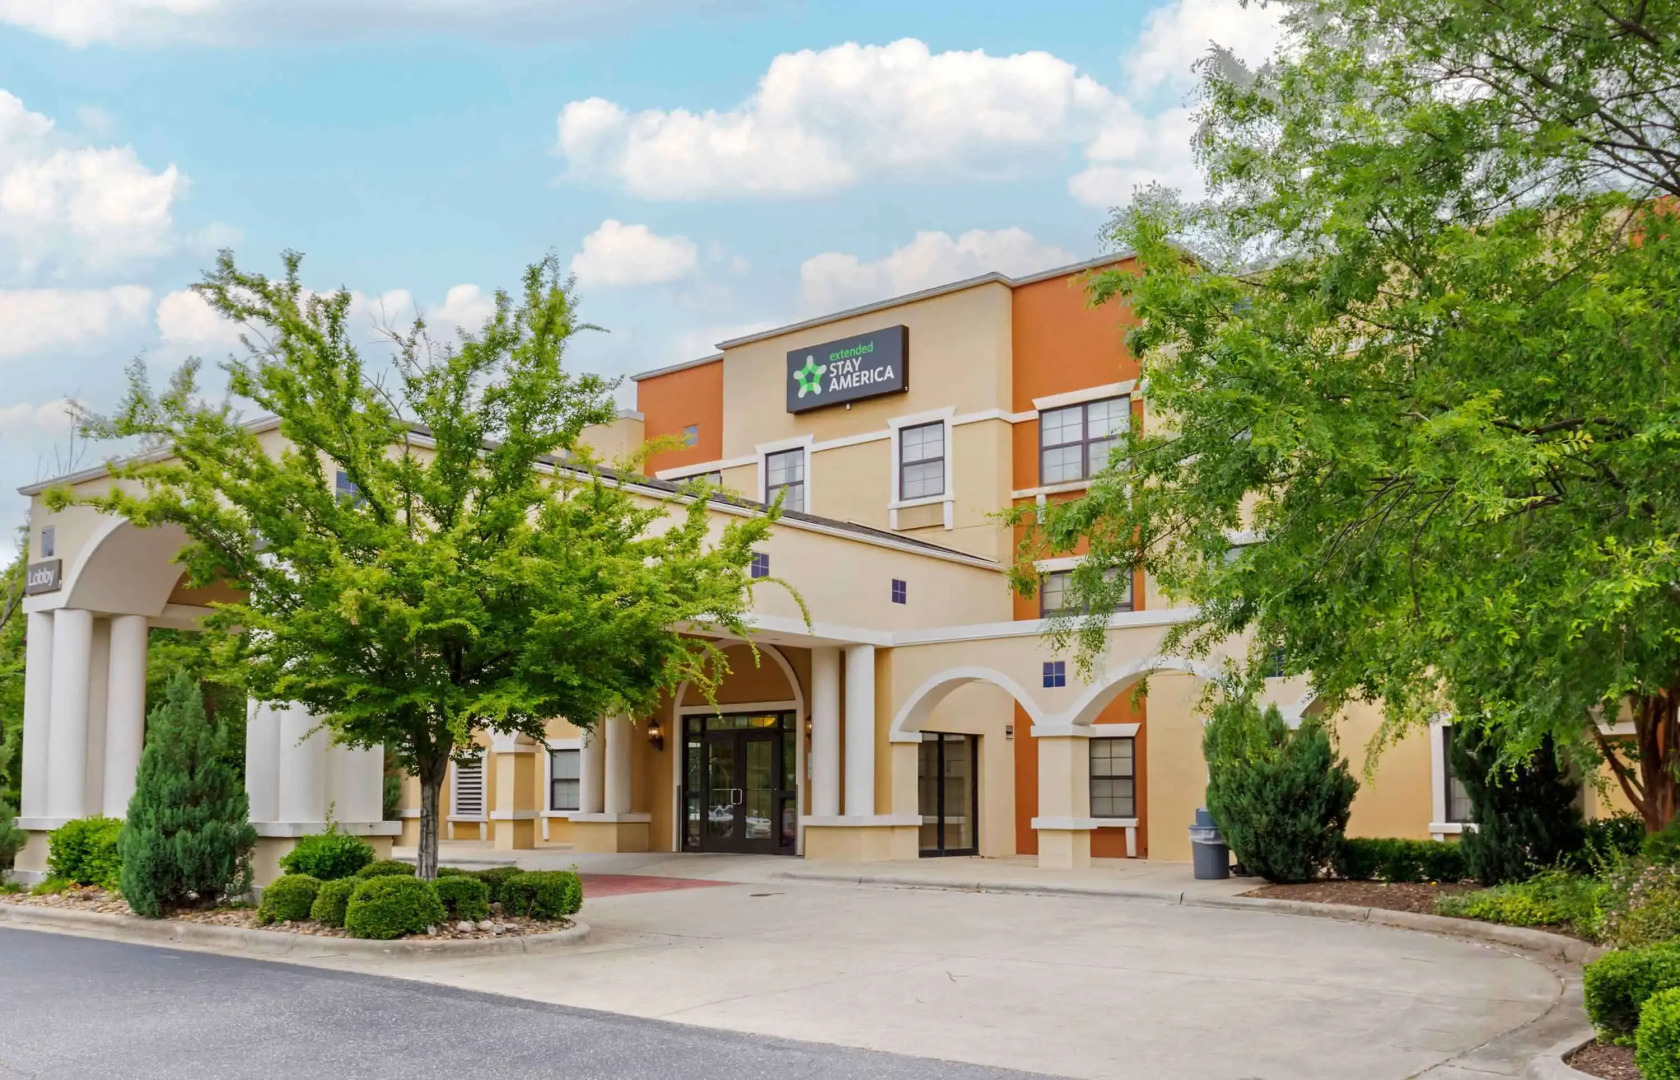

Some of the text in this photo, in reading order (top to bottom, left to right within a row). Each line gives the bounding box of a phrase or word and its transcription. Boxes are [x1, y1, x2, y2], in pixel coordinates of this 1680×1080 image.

[829, 341, 874, 361] extended
[829, 357, 862, 377] STAY
[829, 365, 895, 392] AMERICA
[28, 567, 54, 586] Lobby
